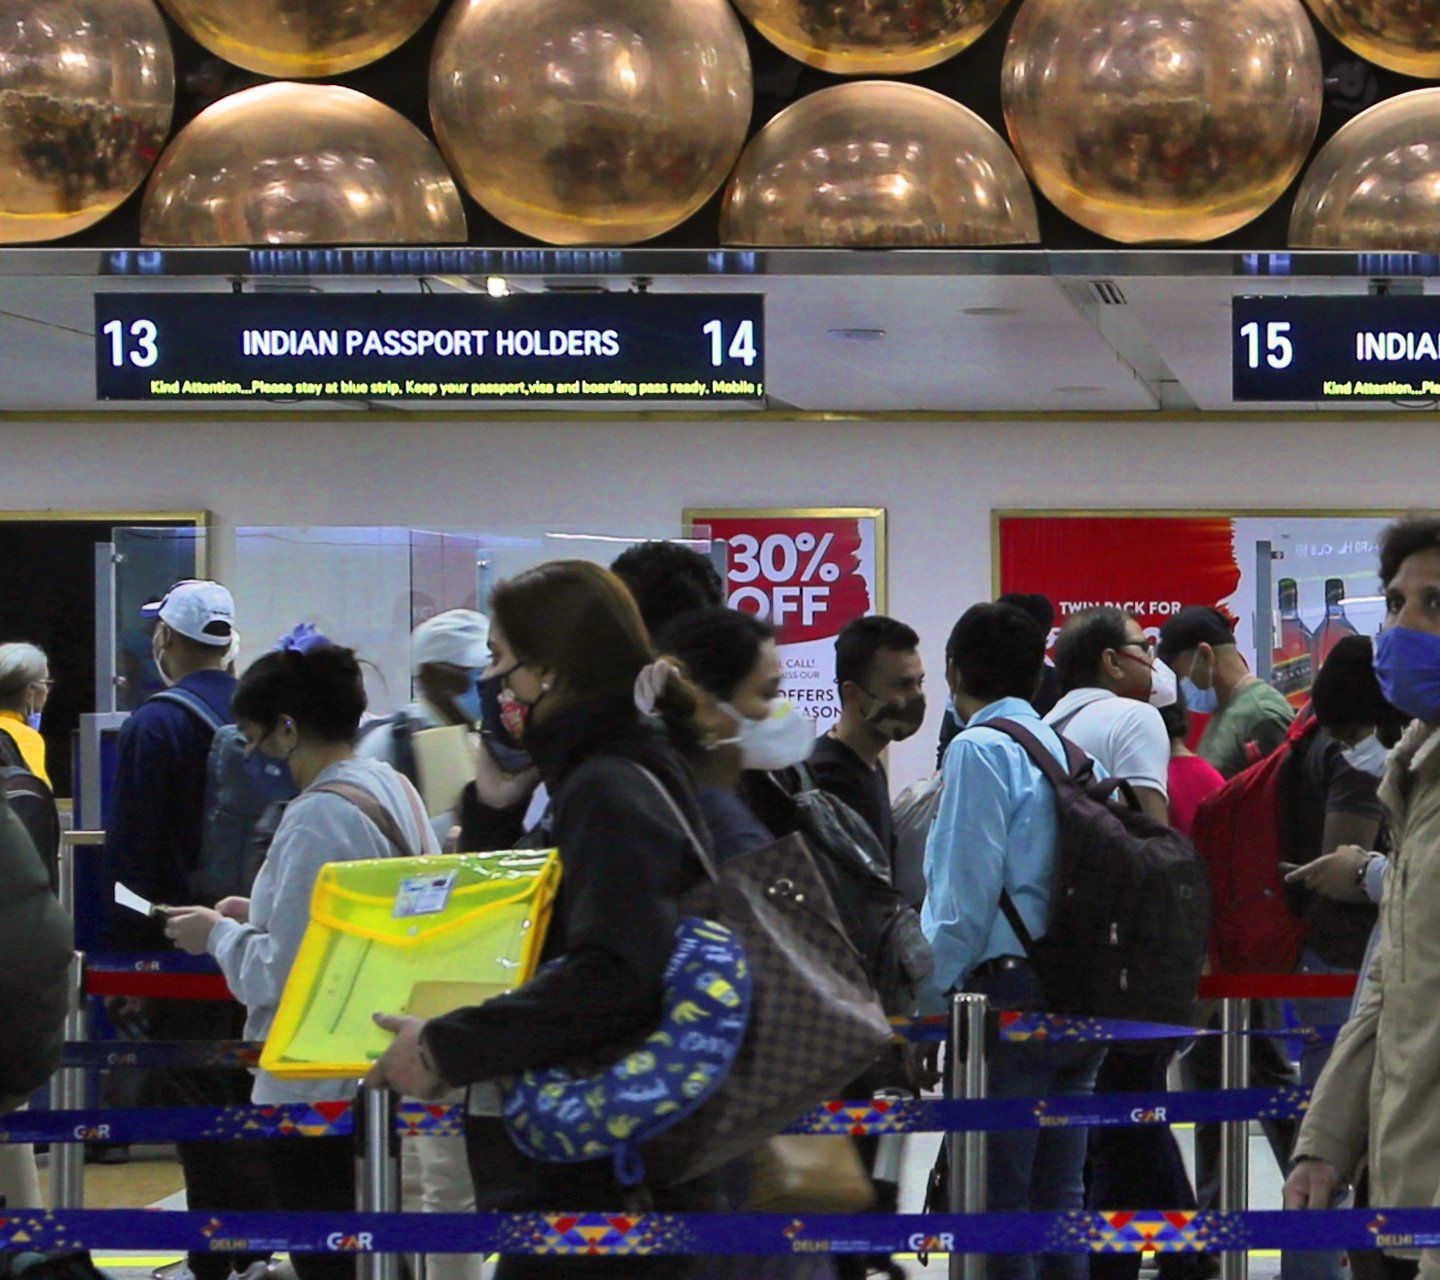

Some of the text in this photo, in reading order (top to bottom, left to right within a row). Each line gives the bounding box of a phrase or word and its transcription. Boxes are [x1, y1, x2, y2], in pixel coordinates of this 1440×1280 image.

[104, 319, 158, 366] 13
[242, 330, 619, 356] INDIAN PASSPORT HOLDERS
[703, 320, 757, 366] 14
[1240, 322, 1293, 369] 15
[150, 380, 179, 394] Kind
[295, 382, 322, 396] stay
[325, 382, 338, 395] at
[341, 380, 369, 394] blue
[406, 381, 437, 396] Keep
[440, 384, 469, 396] your
[556, 381, 580, 394] and
[582, 380, 637, 397] boarding
[639, 384, 668, 397] pass
[713, 380, 754, 394] Mobile
[1323, 381, 1352, 395] Kind
[727, 531, 840, 583] 30%
[728, 586, 830, 626] OFF
[1150, 602, 1181, 614] FOR
[786, 658, 815, 668] CALL!
[800, 671, 819, 680] OUR
[802, 705, 842, 719] ASON
